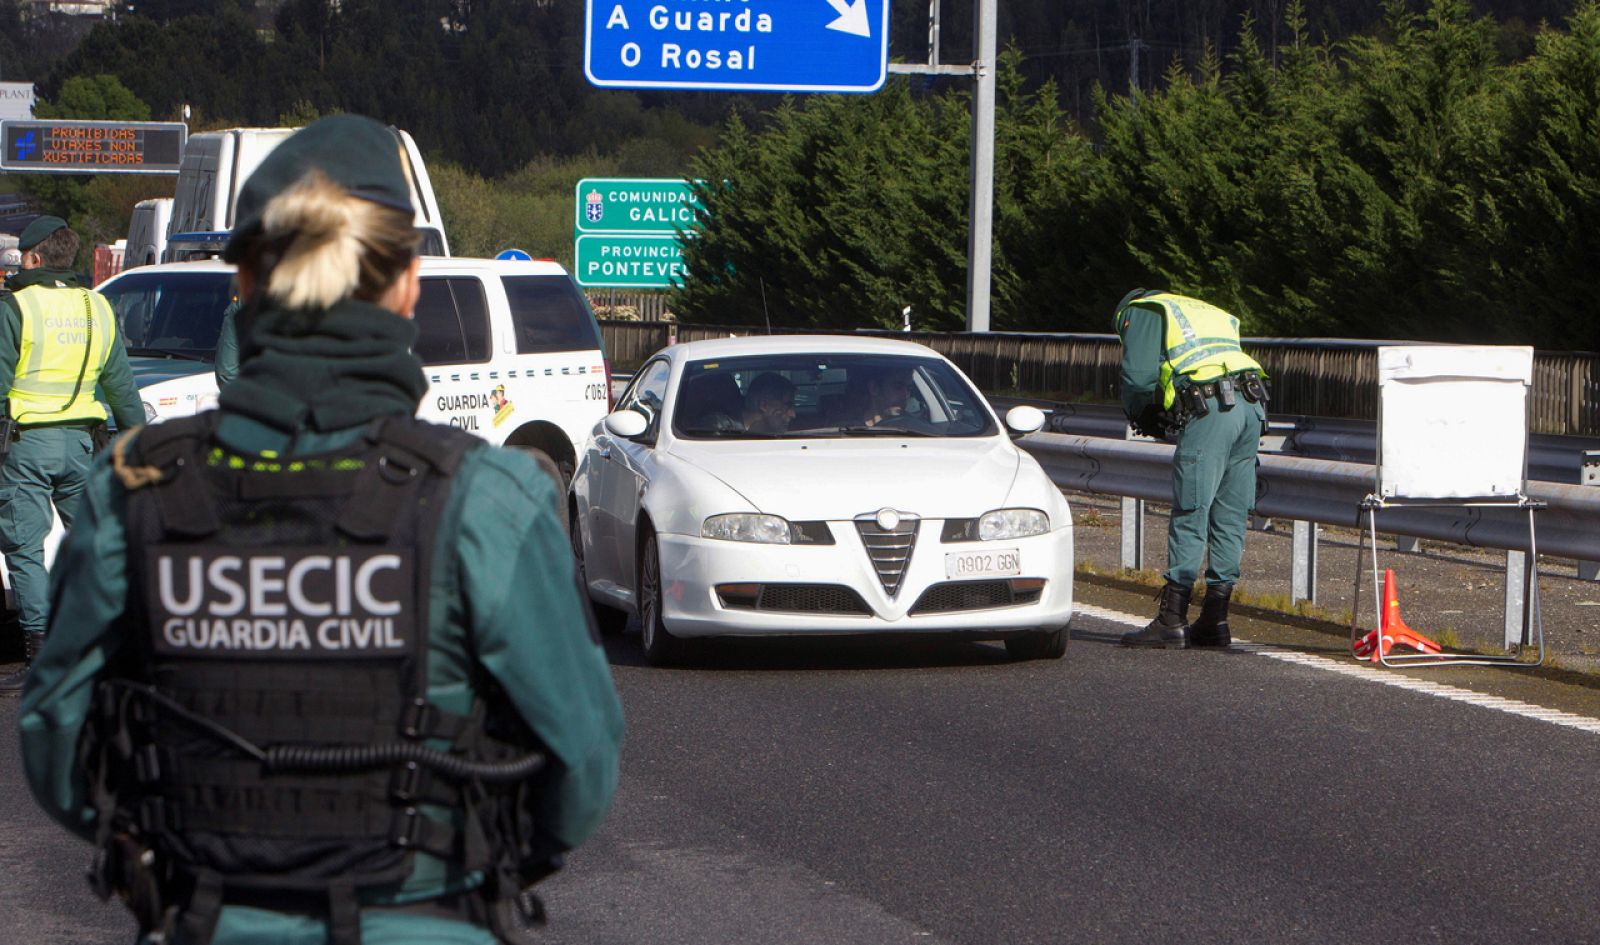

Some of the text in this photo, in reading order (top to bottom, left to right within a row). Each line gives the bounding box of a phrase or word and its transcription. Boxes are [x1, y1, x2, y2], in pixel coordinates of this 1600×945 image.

[606, 5, 773, 32] A Guarda
[620, 42, 755, 70] O Rosal
[51, 127, 136, 139] PROHIBIDAS
[51, 140, 136, 151] VIAXES NON
[43, 152, 144, 164] XUSTIFICADAS
[57, 332, 88, 345] CIVIL
[591, 384, 607, 400] 062
[437, 394, 490, 411] GUARDIA
[158, 555, 402, 616] USECIC
[163, 618, 404, 649] GUARDIA CIVIL
